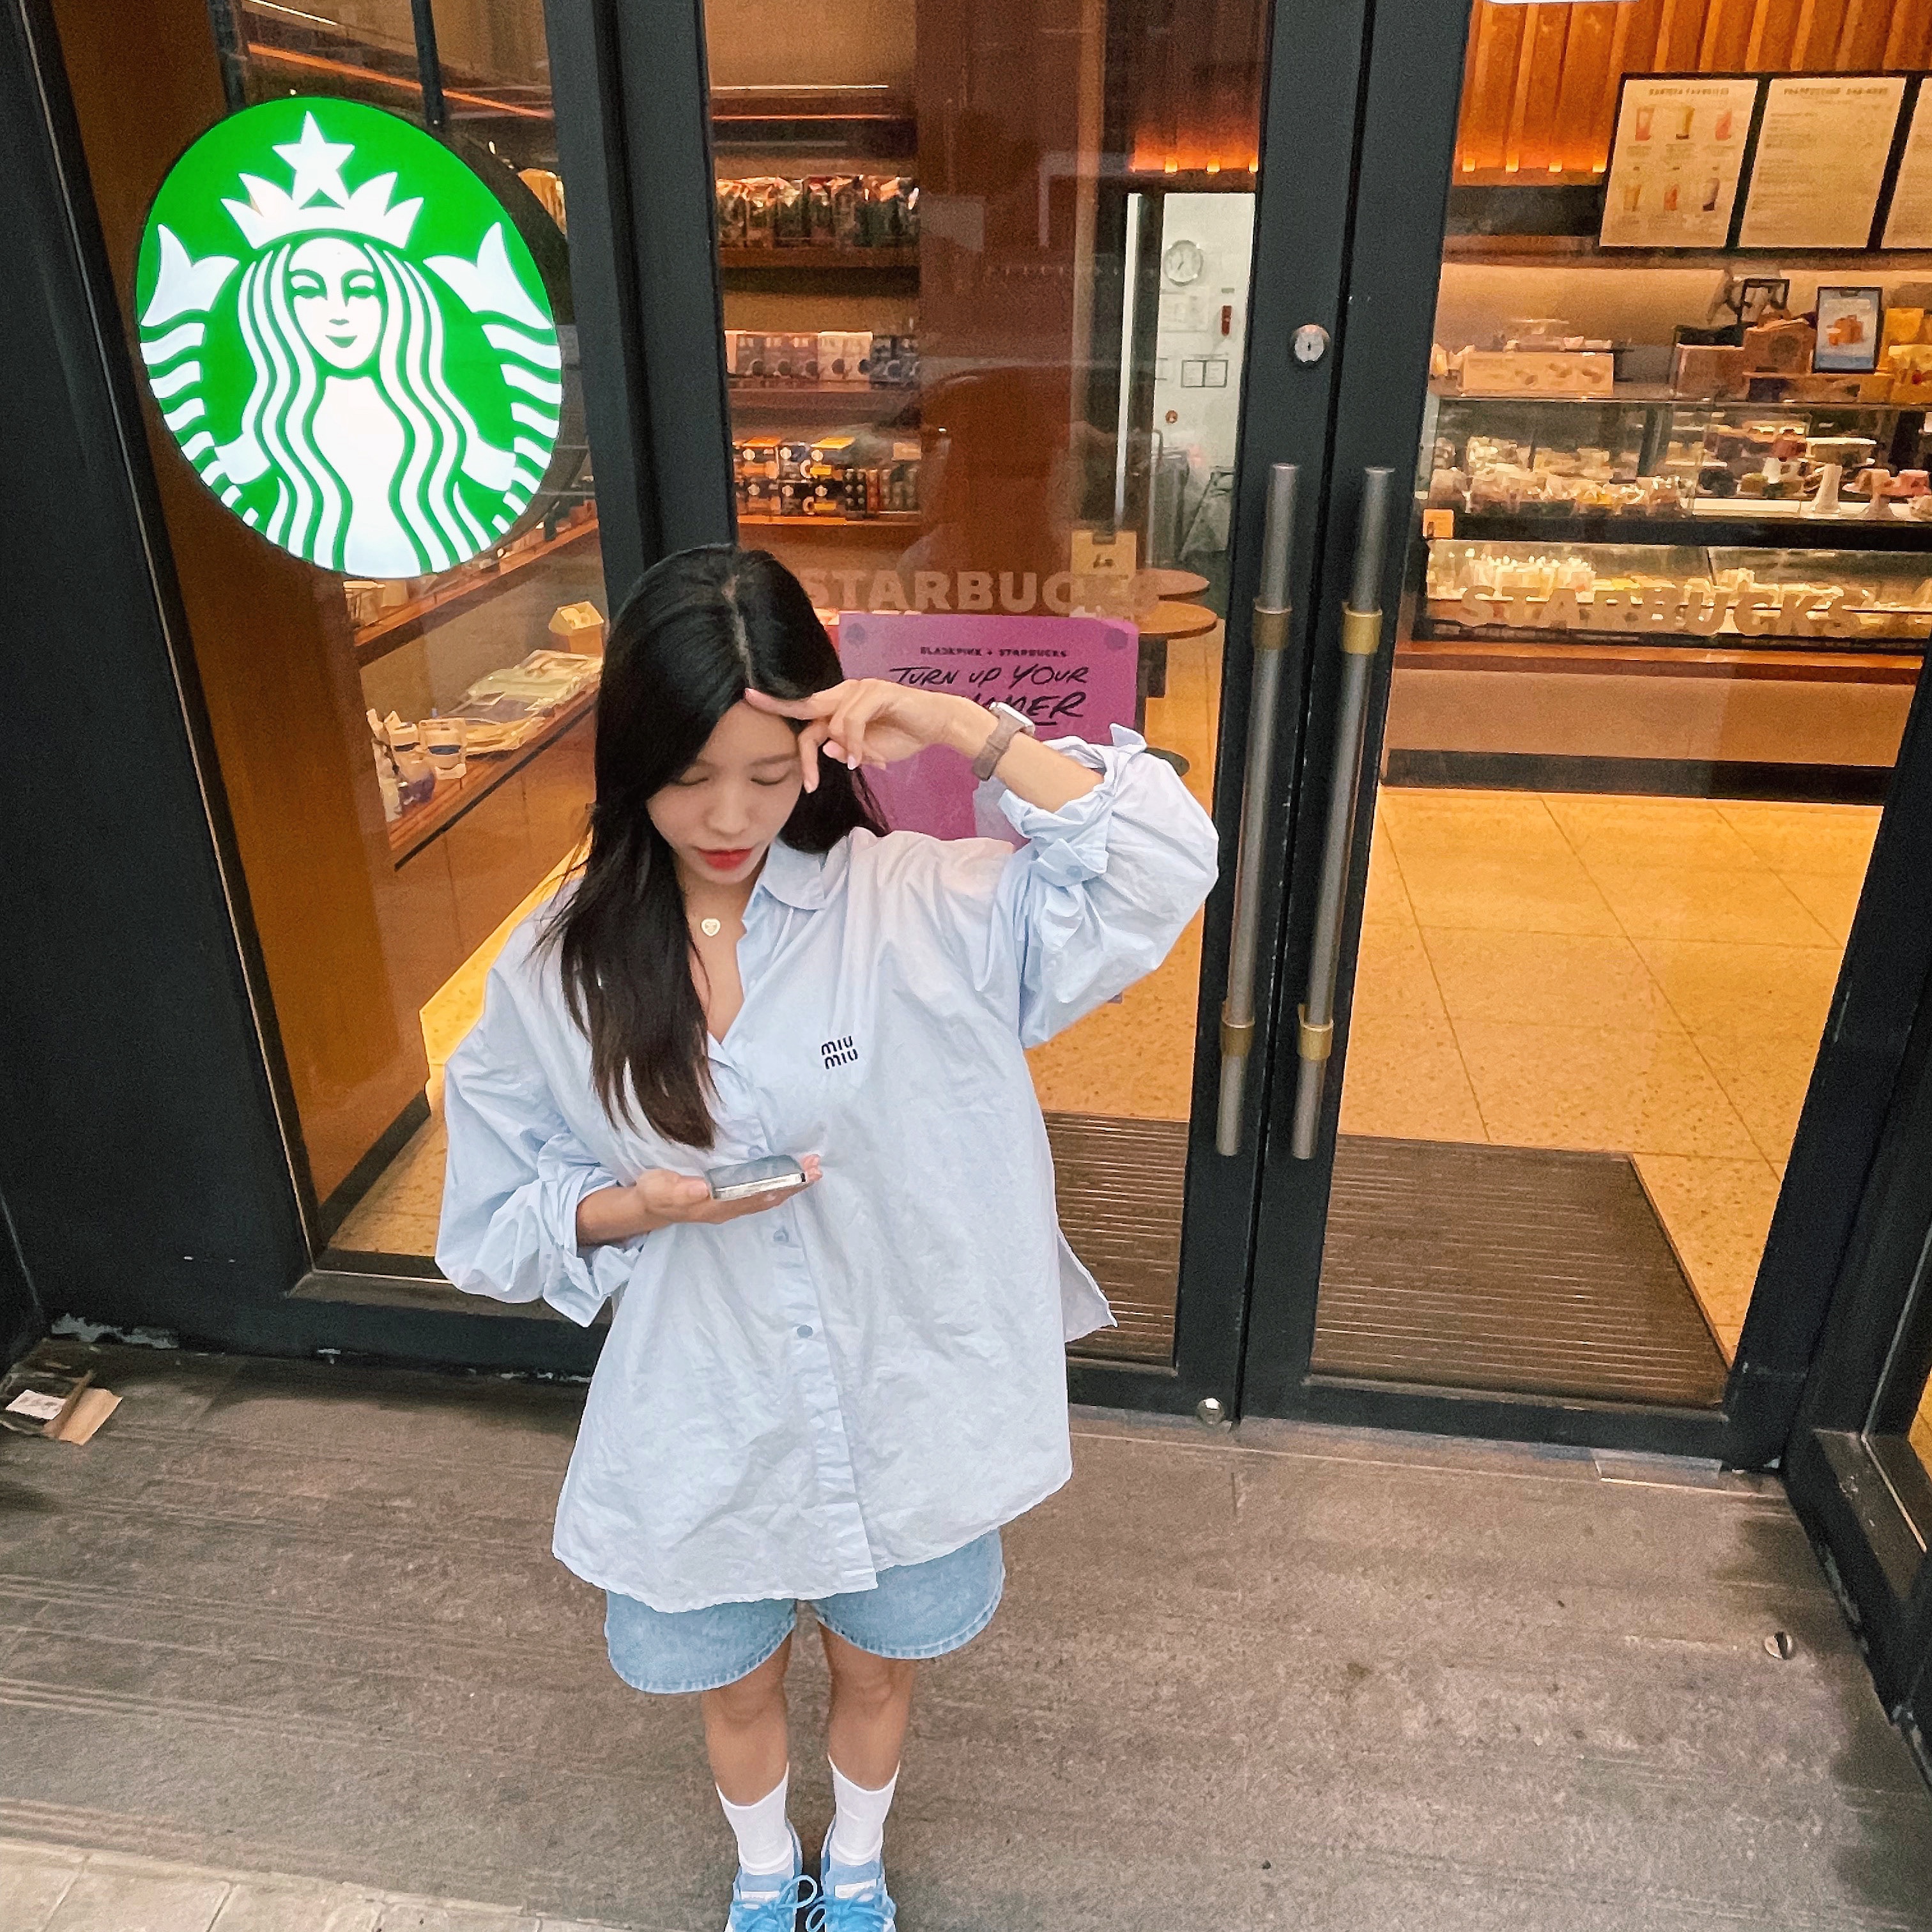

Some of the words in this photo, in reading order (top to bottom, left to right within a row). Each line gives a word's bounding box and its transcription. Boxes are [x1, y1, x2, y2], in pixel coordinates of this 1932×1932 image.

[1456, 584, 1866, 636] STARBUCKS
[889, 666, 958, 686] TURN
[1008, 663, 1089, 689] YOUR
